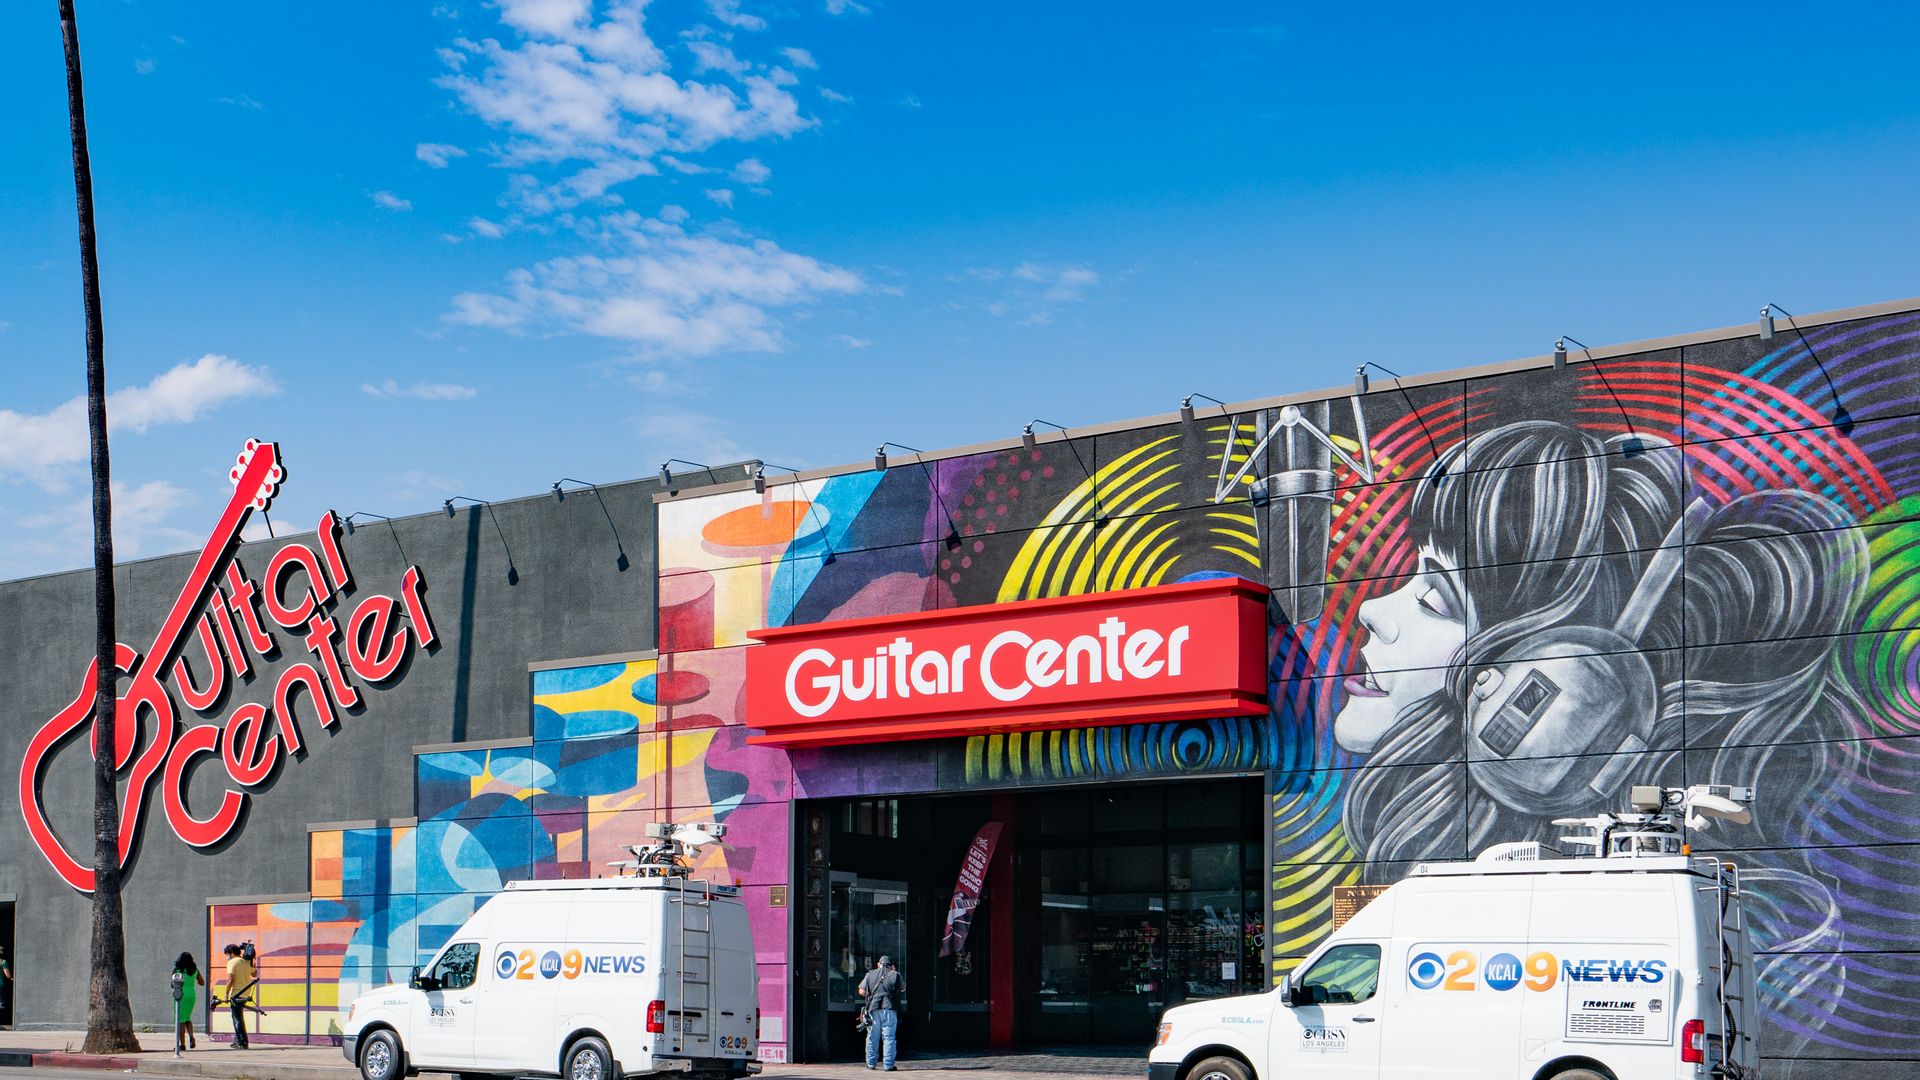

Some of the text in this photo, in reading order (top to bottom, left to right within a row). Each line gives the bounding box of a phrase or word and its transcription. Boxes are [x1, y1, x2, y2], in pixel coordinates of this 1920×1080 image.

[785, 617, 1189, 717] Guitar Center
[163, 565, 435, 848] Center
[962, 869, 982, 886] MUSIC
[968, 864, 981, 876] THE
[959, 875, 979, 893] GOING
[516, 949, 645, 980] 2 KCAL 9 NEWS
[1444, 950, 1667, 993] 2 KCAL 9 NEWS
[1582, 1000, 1637, 1009] FRONTLINE
